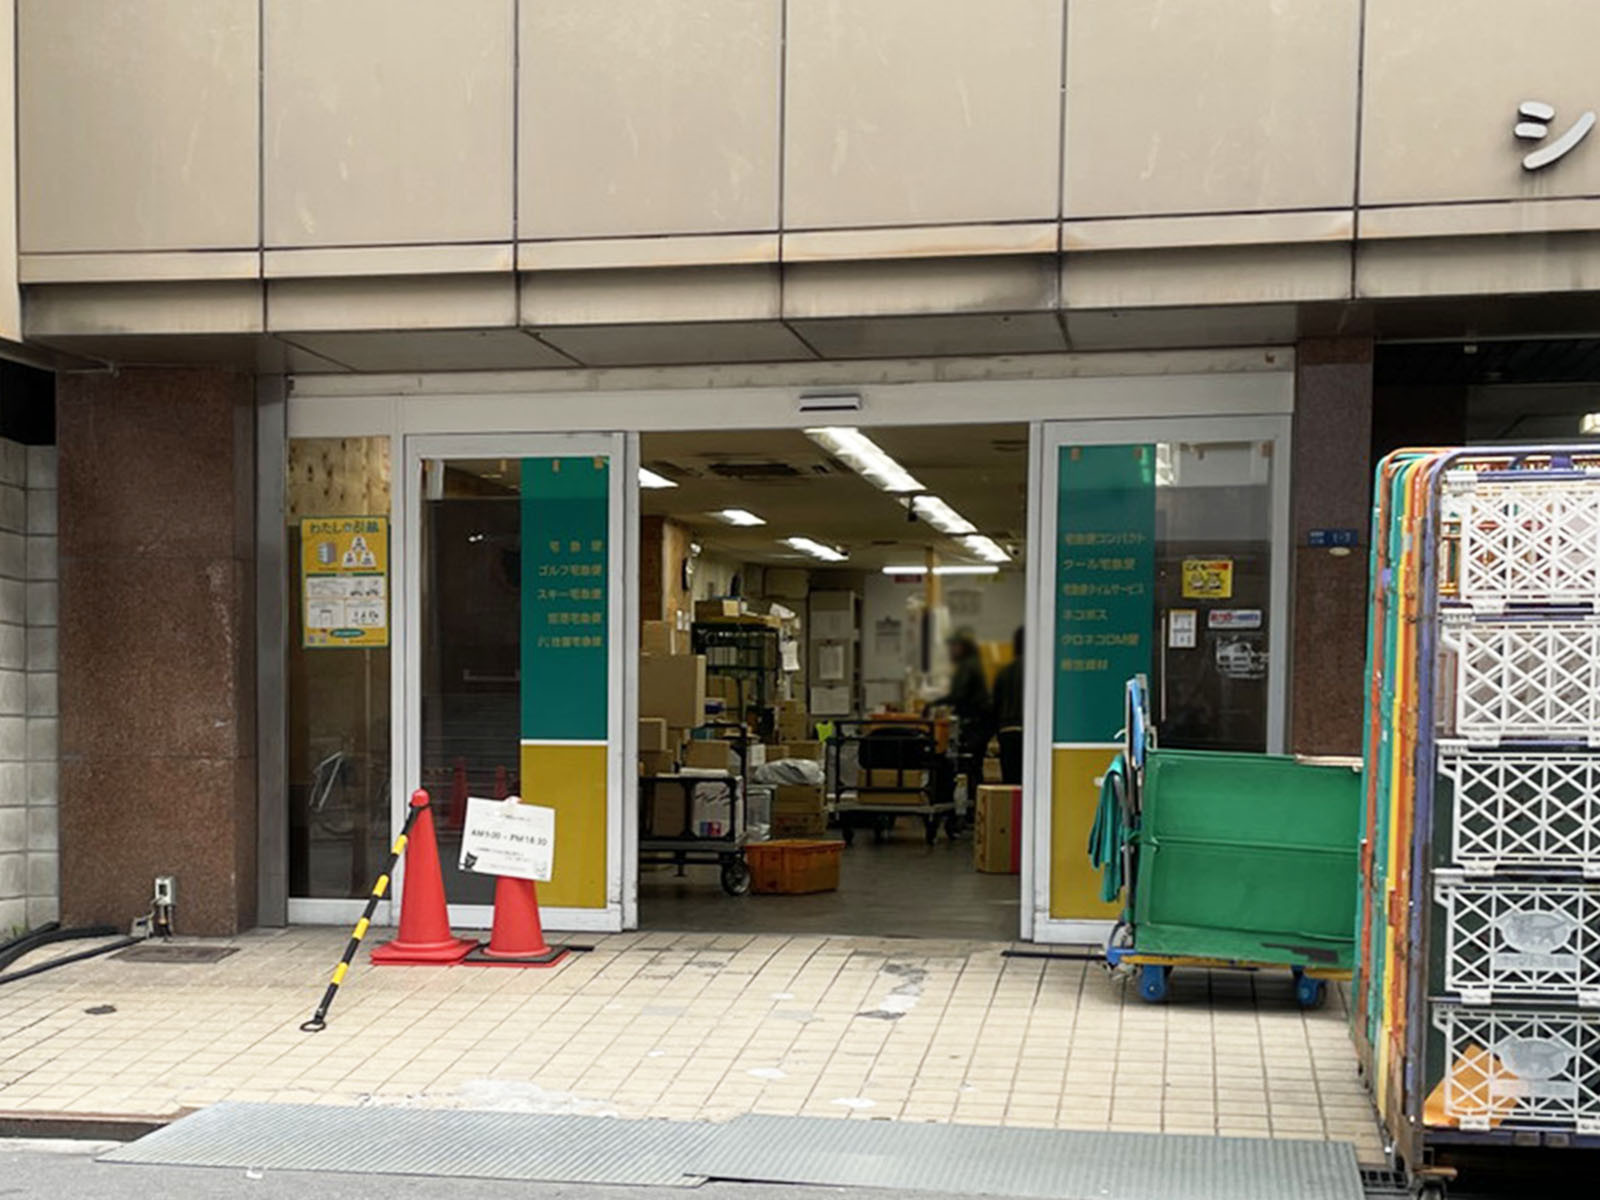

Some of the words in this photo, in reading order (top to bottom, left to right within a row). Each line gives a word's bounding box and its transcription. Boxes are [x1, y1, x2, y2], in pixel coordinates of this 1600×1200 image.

[1514, 101, 1597, 169] シ
[537, 563, 603, 577] ゴルフ宅急便
[536, 587, 603, 602] スキー宅急便
[1062, 607, 1109, 621] ネコポス
[1061, 631, 1140, 646] クロネコDM便
